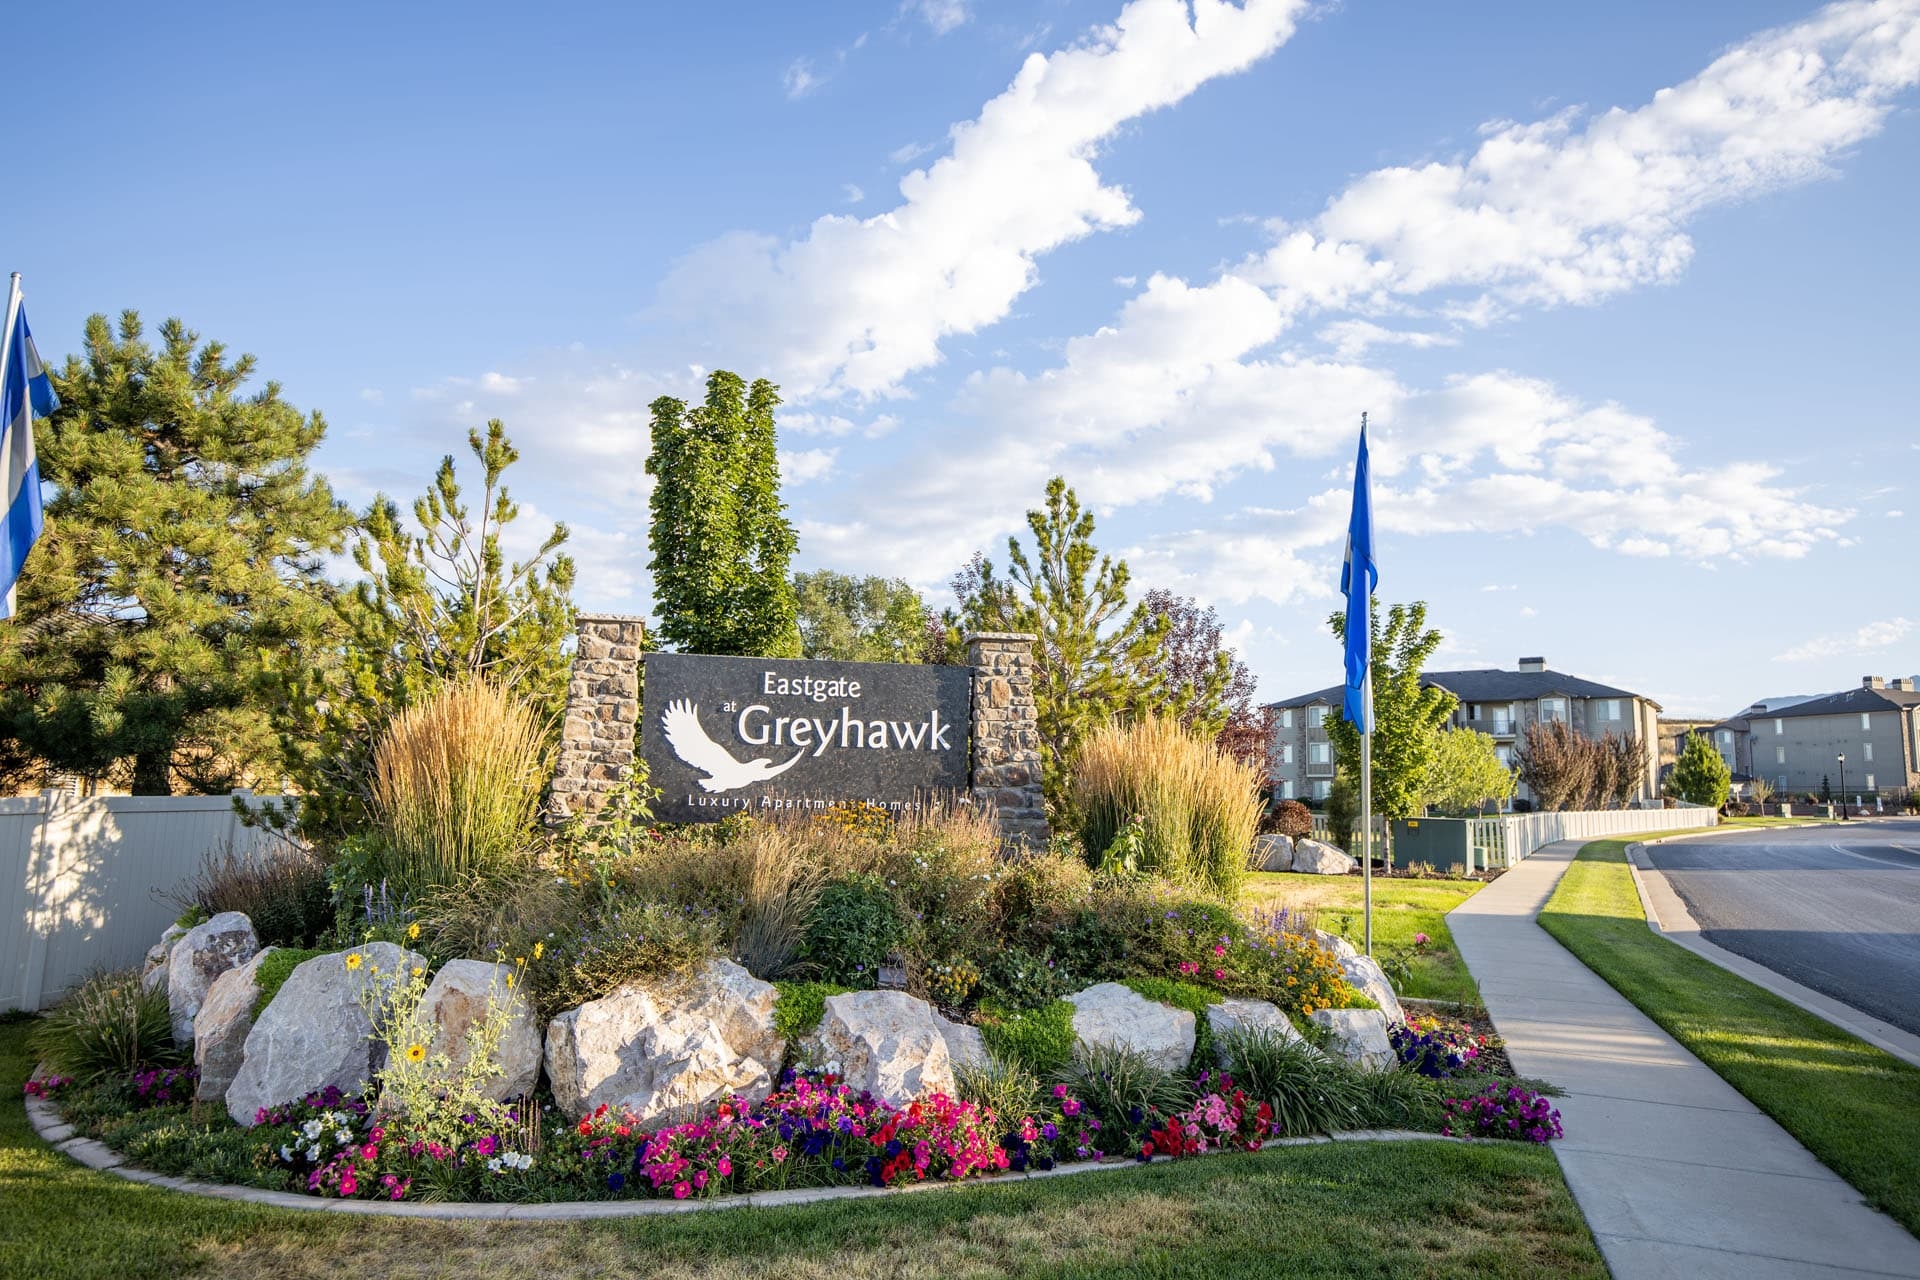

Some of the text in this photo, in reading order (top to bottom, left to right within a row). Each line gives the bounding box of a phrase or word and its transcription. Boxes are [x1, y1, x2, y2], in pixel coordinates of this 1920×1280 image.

[764, 671, 861, 702] Eastgate
[723, 700, 952, 757] at Greyhawk
[688, 794, 921, 810] Luxury Apartmen Homes
